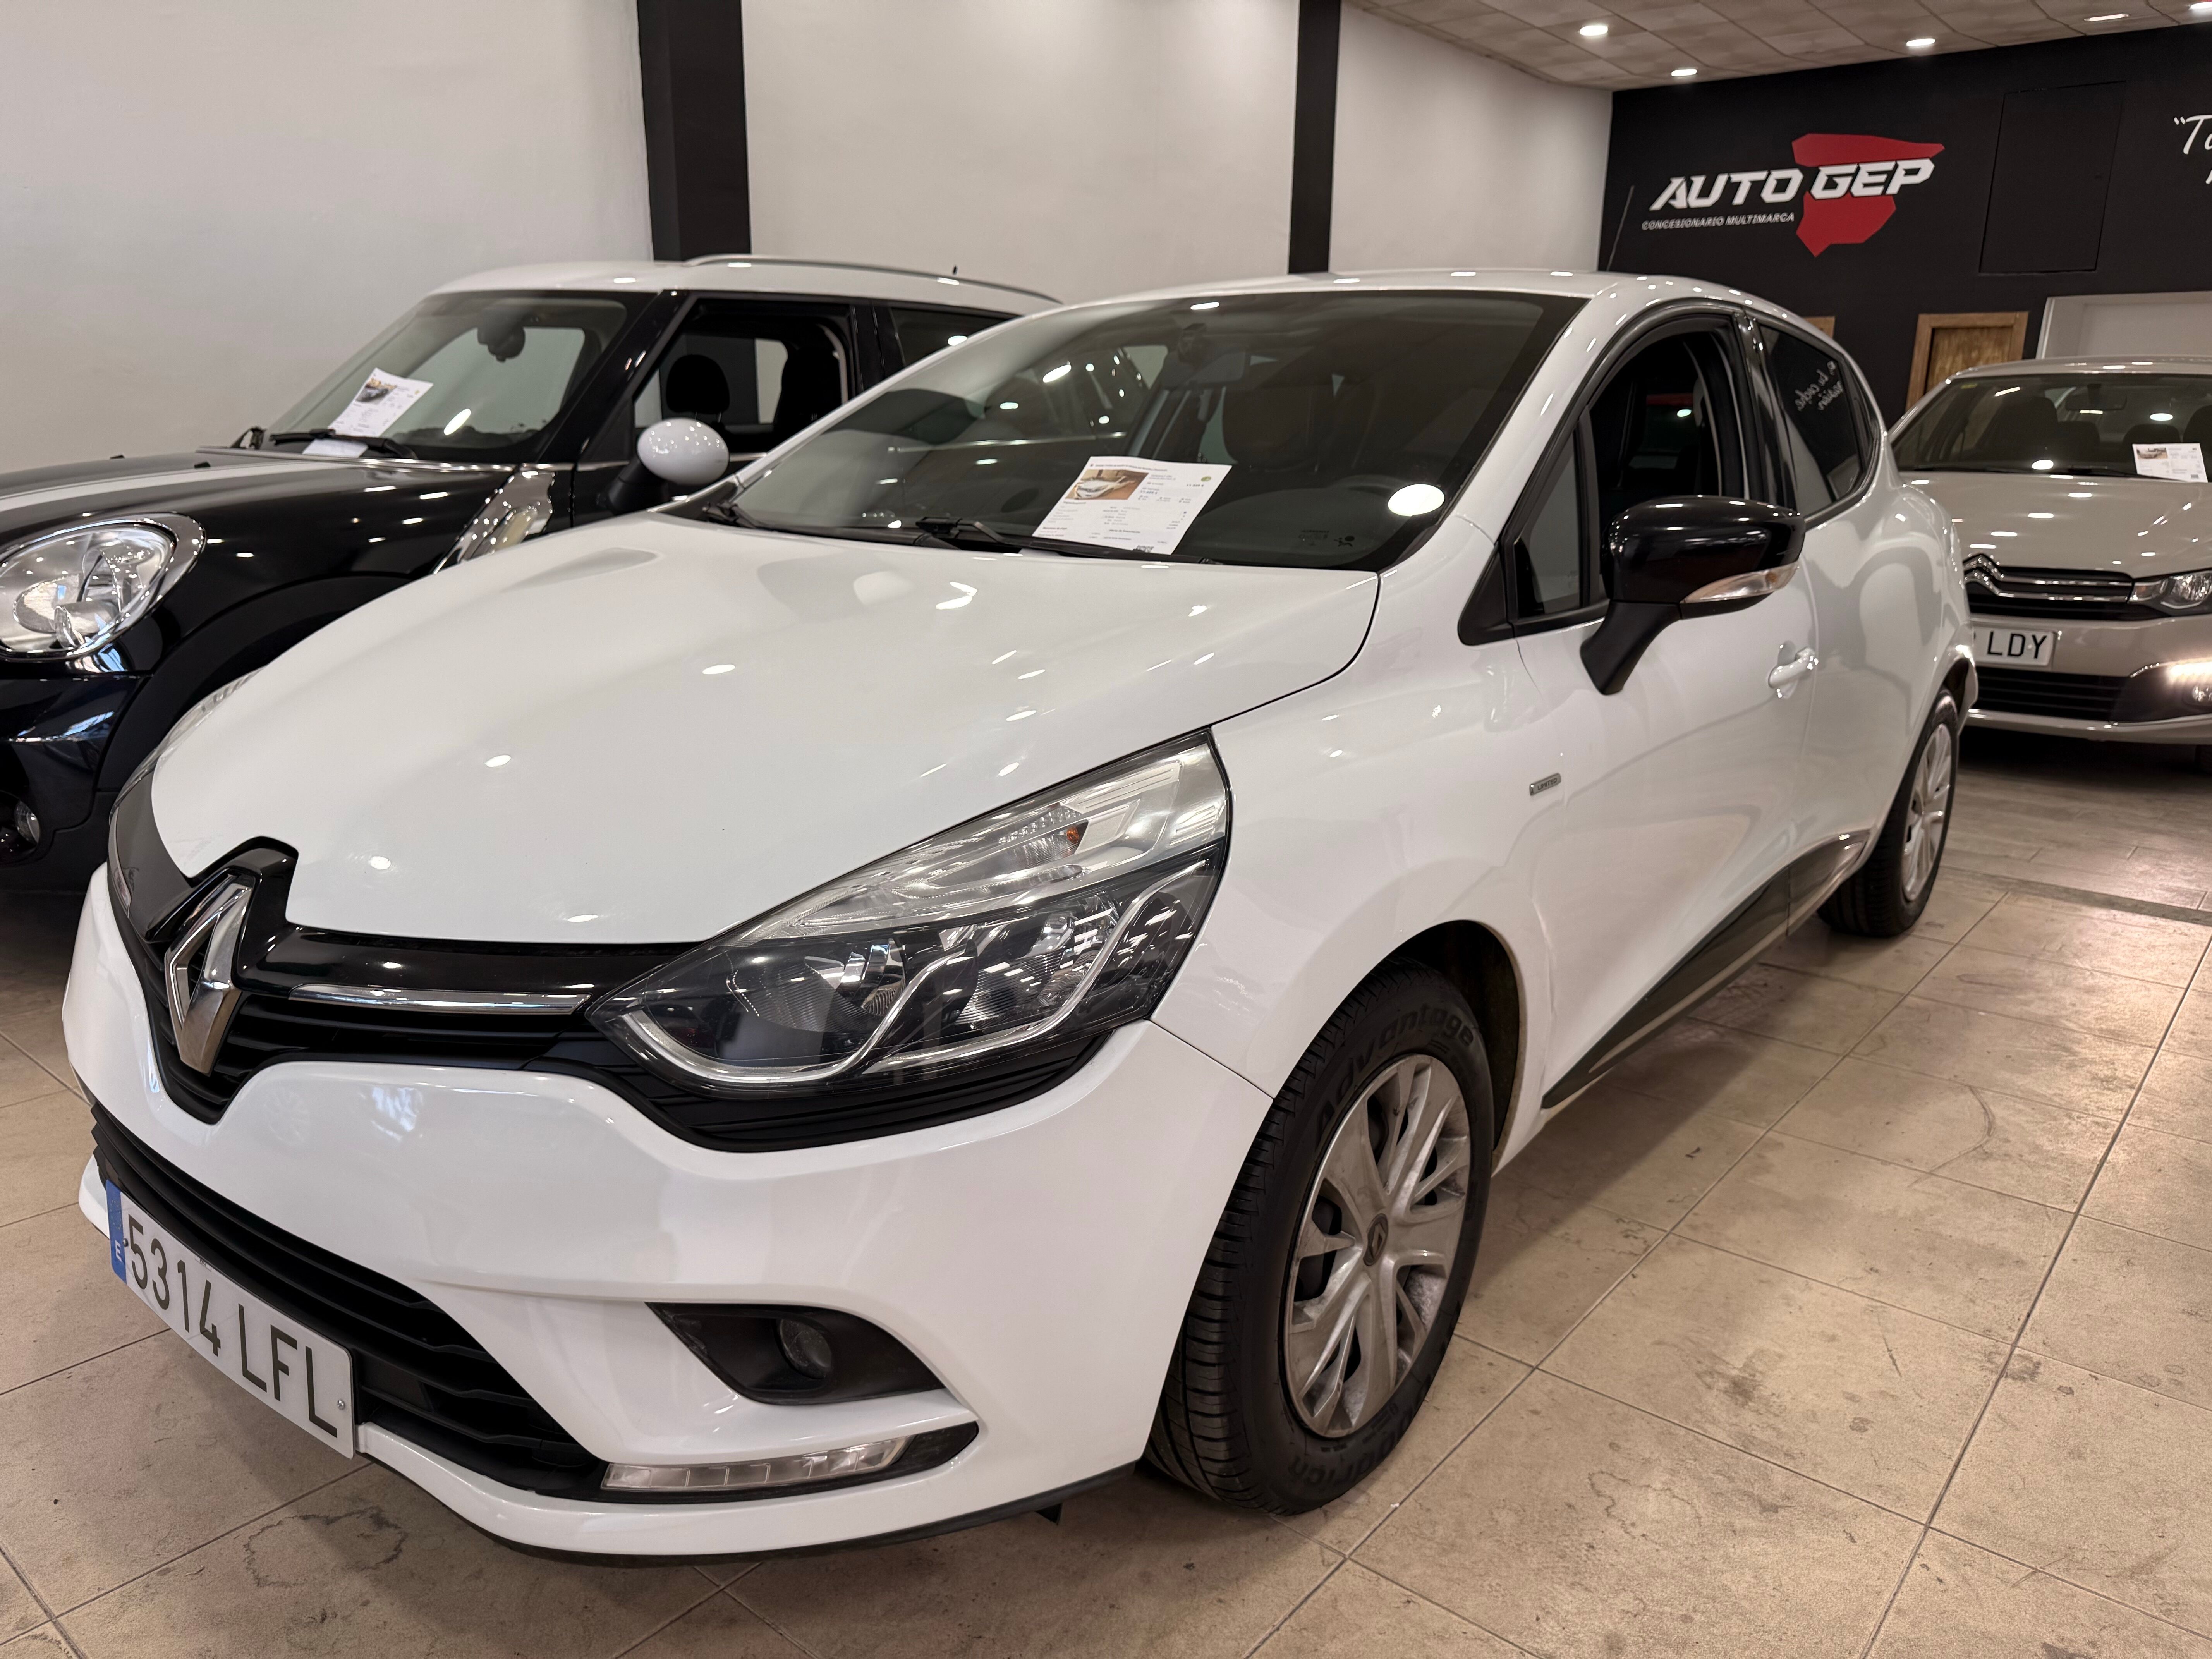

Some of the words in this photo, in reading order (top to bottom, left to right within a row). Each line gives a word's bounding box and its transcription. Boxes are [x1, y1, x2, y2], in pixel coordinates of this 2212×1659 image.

[1649, 168, 1804, 211] AUTO
[1810, 158, 1935, 200] GEP
[1642, 216, 1724, 231] CONCESIONARIO
[1725, 212, 1795, 225] MULTIMARCA
[1987, 631, 2047, 659] LDY
[1537, 778, 1558, 790] LIMITED
[1315, 1002, 1474, 1152] Advantage
[115, 1239, 122, 1262] E
[128, 1214, 221, 1357] 5314
[239, 1304, 337, 1438] LFL
